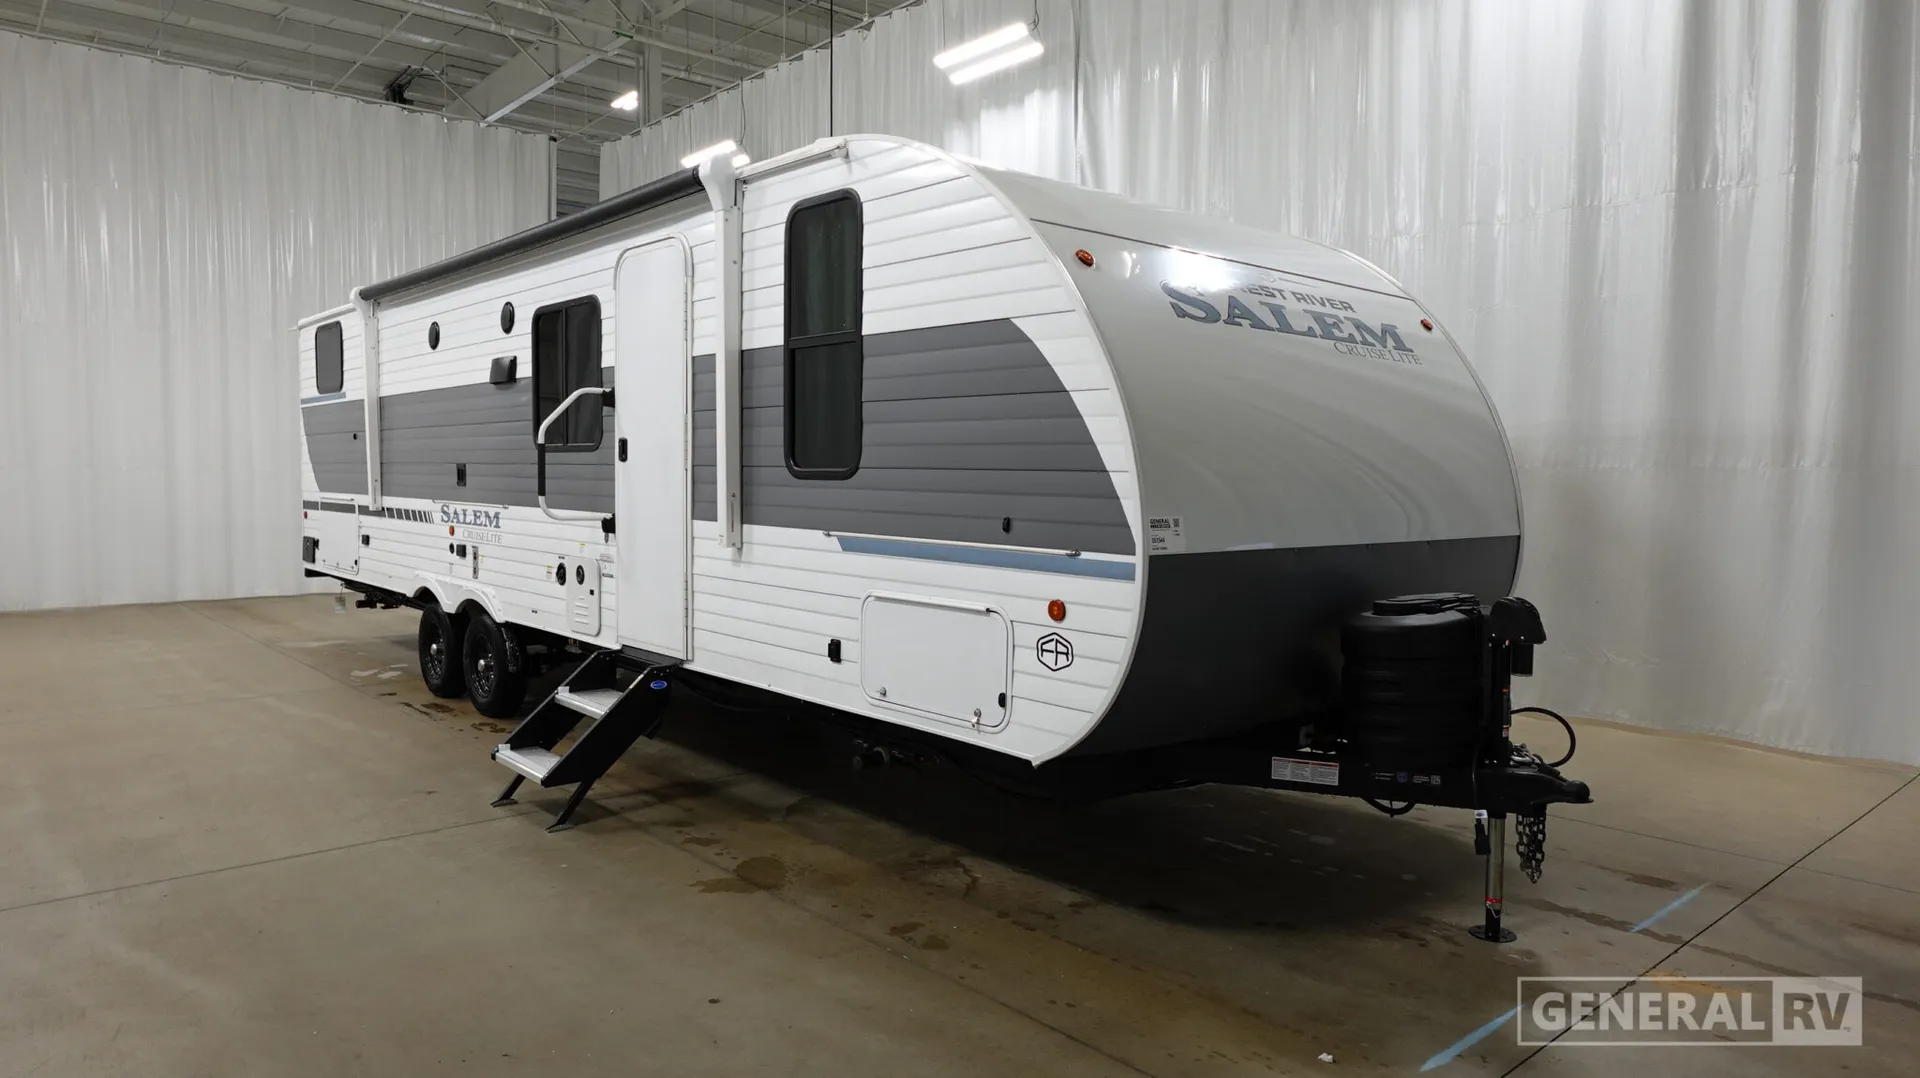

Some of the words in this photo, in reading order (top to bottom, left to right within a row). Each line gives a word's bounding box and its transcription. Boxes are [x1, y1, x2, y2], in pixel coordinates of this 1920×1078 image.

[1296, 292, 1356, 313] RIVER
[1159, 280, 1414, 353] SALEM
[440, 503, 501, 529] SALEM
